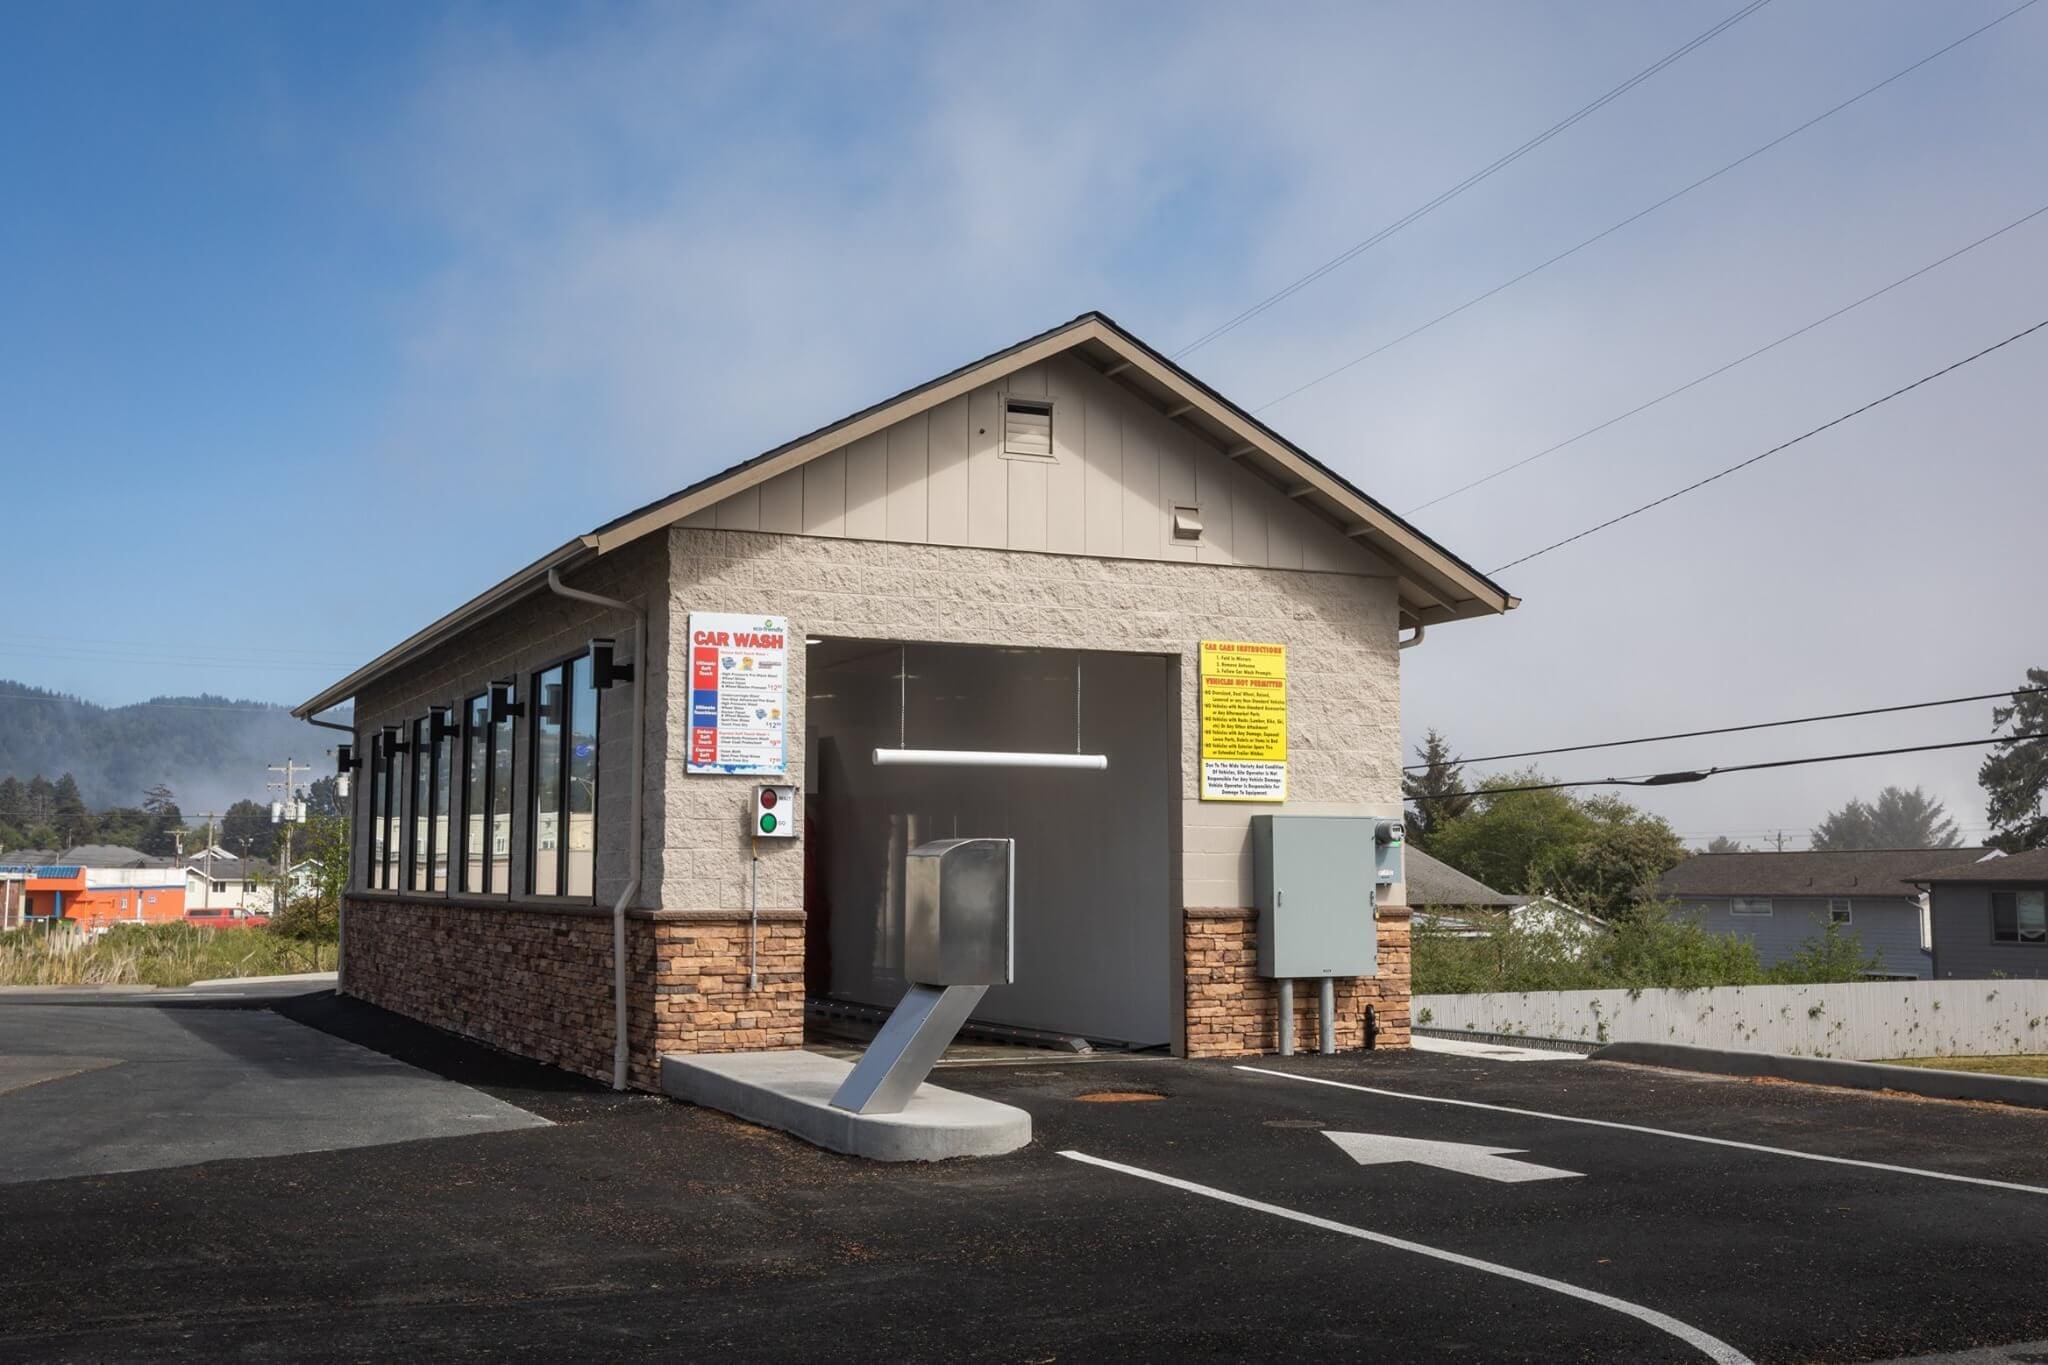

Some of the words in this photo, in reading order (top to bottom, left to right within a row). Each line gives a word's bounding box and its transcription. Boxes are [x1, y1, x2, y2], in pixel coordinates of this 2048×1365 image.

[694, 631, 729, 646] CAR
[733, 632, 783, 649] WASH
[1237, 645, 1282, 654] INSTRUCTIONS
[1250, 680, 1282, 688] PERMITTED
